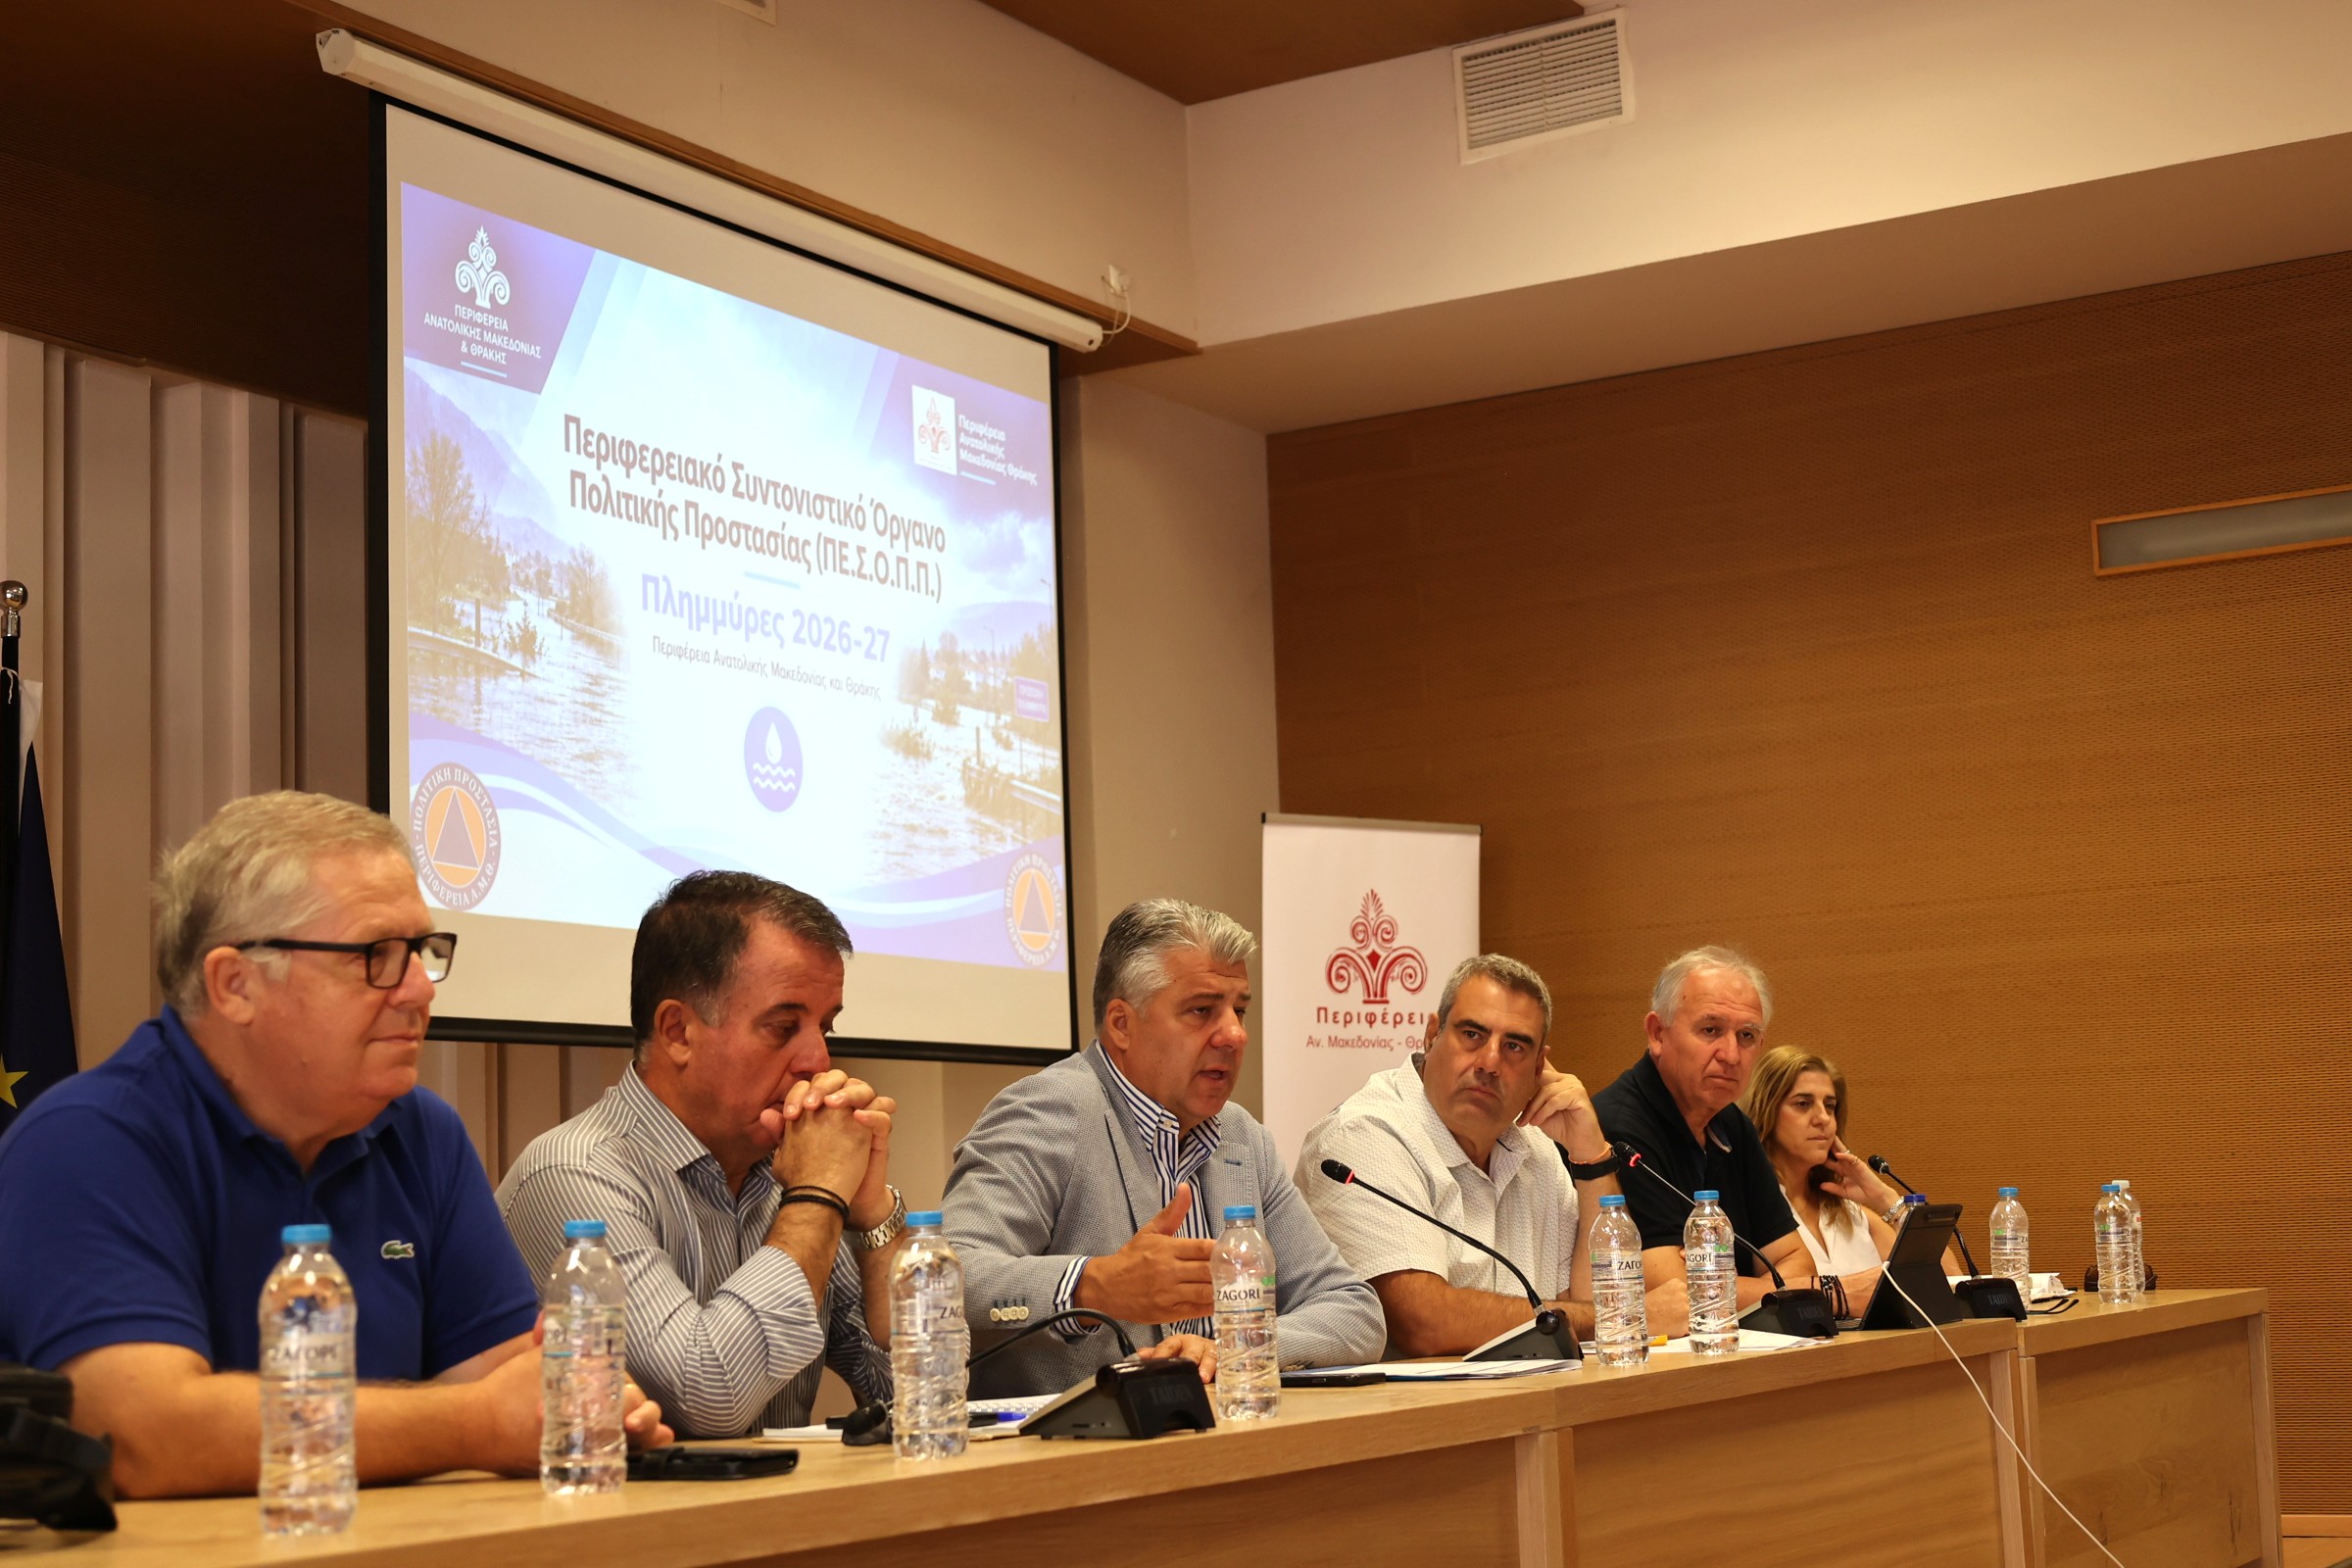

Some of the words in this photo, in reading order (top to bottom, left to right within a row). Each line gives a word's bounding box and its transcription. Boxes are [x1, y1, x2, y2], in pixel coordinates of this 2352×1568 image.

[423, 312, 482, 341] ΑΝΑΤΟΛΙΚΗΣ
[483, 331, 542, 359] ΜΑΚΕΔΟΝΙΑΣ
[454, 304, 509, 332] ΠΕΡΙΦΕΡΕΙΑ
[461, 340, 468, 354] &
[470, 343, 507, 365] ΘΡΑΚΗΣ
[564, 413, 725, 494] Περιφερειακό
[731, 461, 866, 532] Συντονιστικό
[869, 497, 946, 553] Όργανο
[569, 469, 679, 542] Πολιτικής
[684, 499, 811, 574] Προστασίας
[816, 531, 942, 604] (ΠΕ.Σ.Ο.Π.Π.)
[642, 573, 784, 649] Πλημμύρες
[792, 609, 891, 662] 2026-27
[653, 635, 710, 663] Περιφέρεια
[713, 649, 768, 679] Ανατολικής
[770, 661, 826, 690] Μακεδονίας
[829, 676, 844, 692] και
[846, 676, 881, 702] Θράκης
[414, 767, 451, 831] ΠΟΛΙΤΙΚΗ
[454, 768, 498, 848] ΠΡΟΣΤΑΣΙΑ
[415, 846, 469, 906] ΠΕΡΙΦΕΡΕΙΑ
[1305, 1035, 1324, 1049] Αν.
[1328, 1035, 1394, 1052] Μακεδονίας
[1316, 1006, 1430, 1029] Περιφέρει
[1216, 1288, 1260, 1301] ZAGORI
